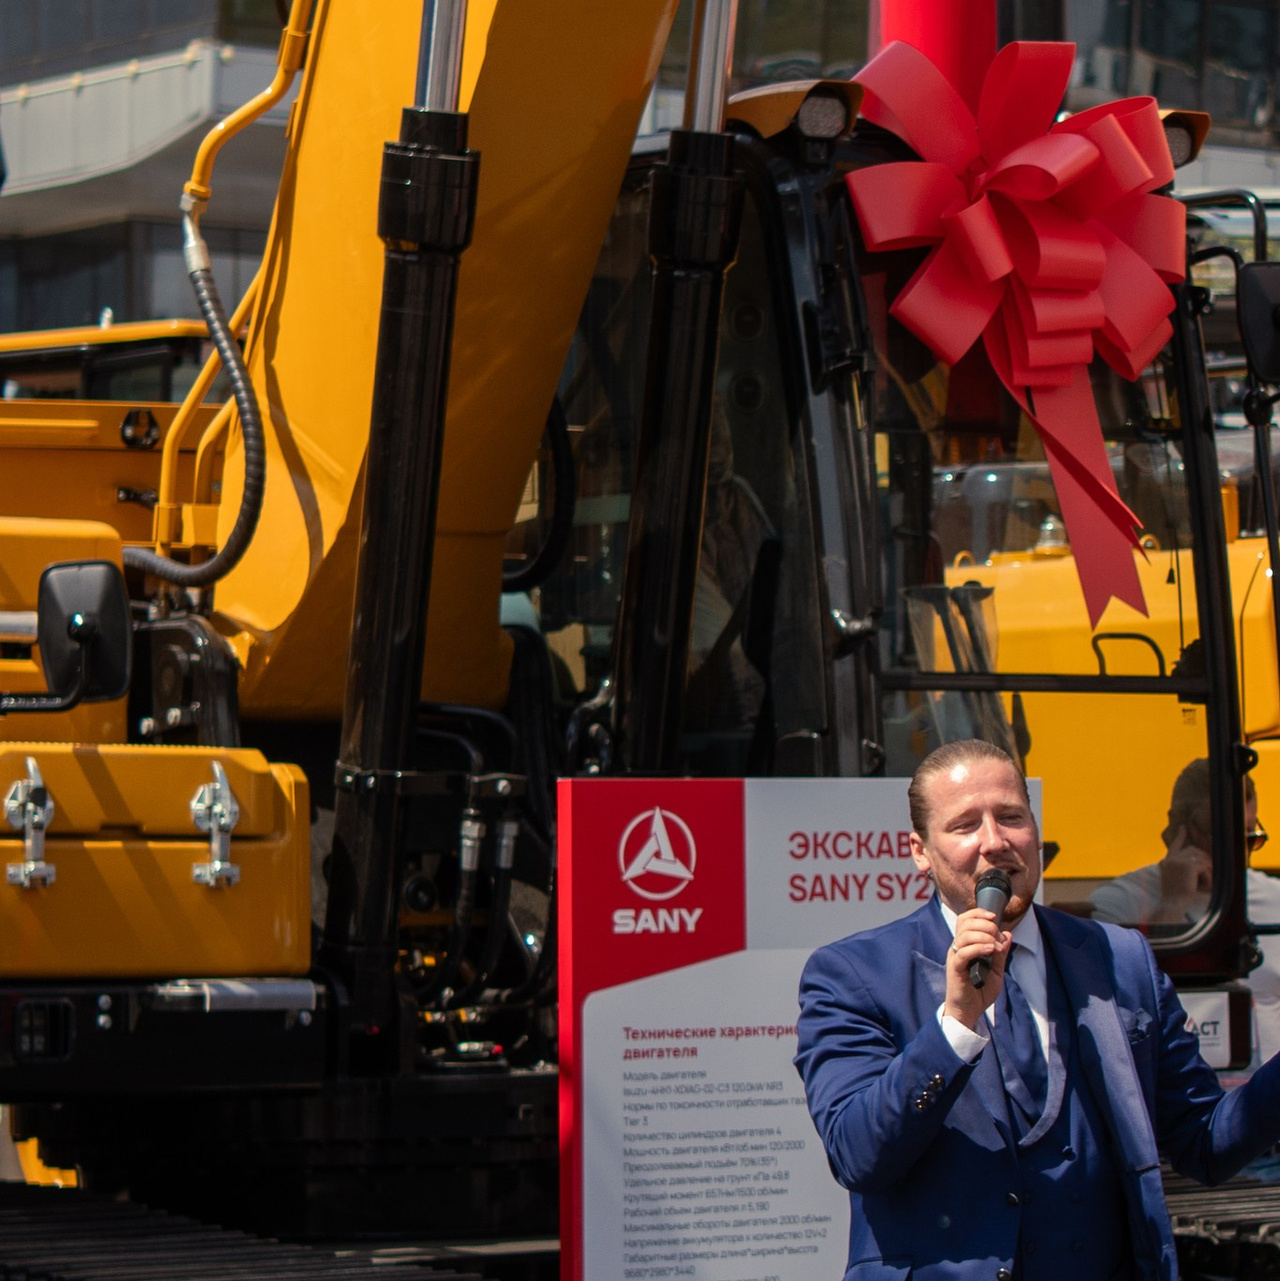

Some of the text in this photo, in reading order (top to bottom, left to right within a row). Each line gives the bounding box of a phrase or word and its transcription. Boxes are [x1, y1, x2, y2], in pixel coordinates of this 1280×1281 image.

[789, 873, 870, 903] SANY
[612, 908, 704, 934] SANY
[623, 1026, 717, 1041] Технические
[623, 1046, 698, 1060] двигателя
